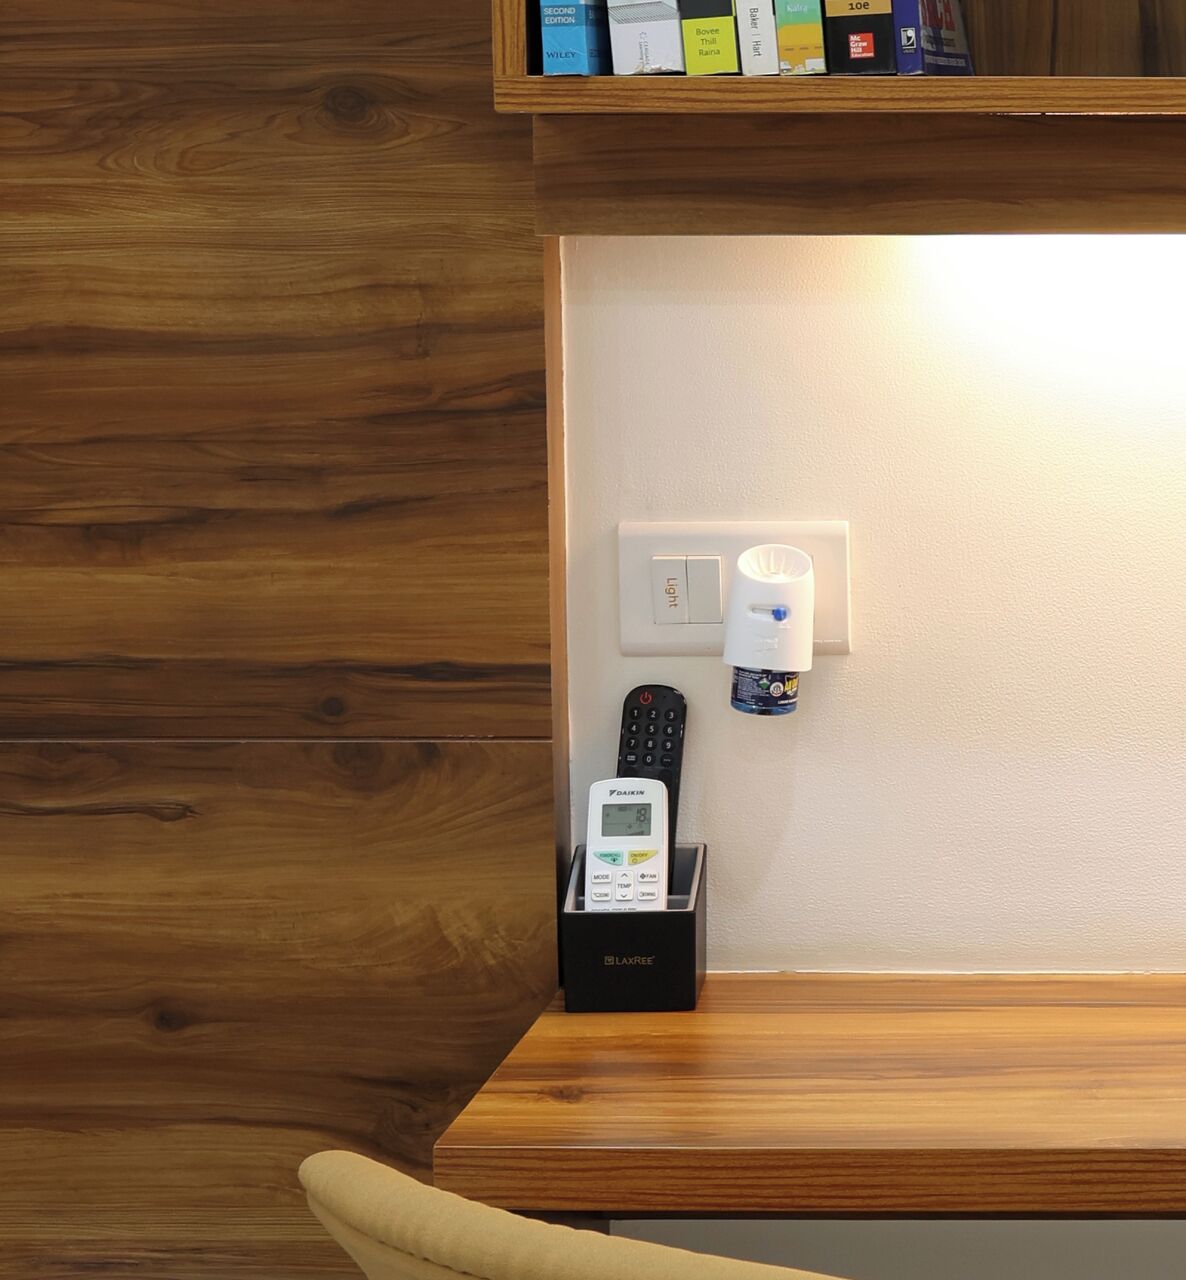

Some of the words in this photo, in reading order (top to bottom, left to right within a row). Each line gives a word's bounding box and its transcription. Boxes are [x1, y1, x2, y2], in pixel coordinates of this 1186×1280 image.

[848, 1, 870, 10] 10e
[543, 7, 576, 15] SECOND
[545, 16, 575, 24] EDITION
[749, 8, 759, 29] Baker
[701, 38, 717, 46] Thill
[698, 48, 720, 56] Raina
[752, 40, 761, 57] Hart
[546, 51, 576, 59] WILEY
[665, 578, 679, 608] Light
